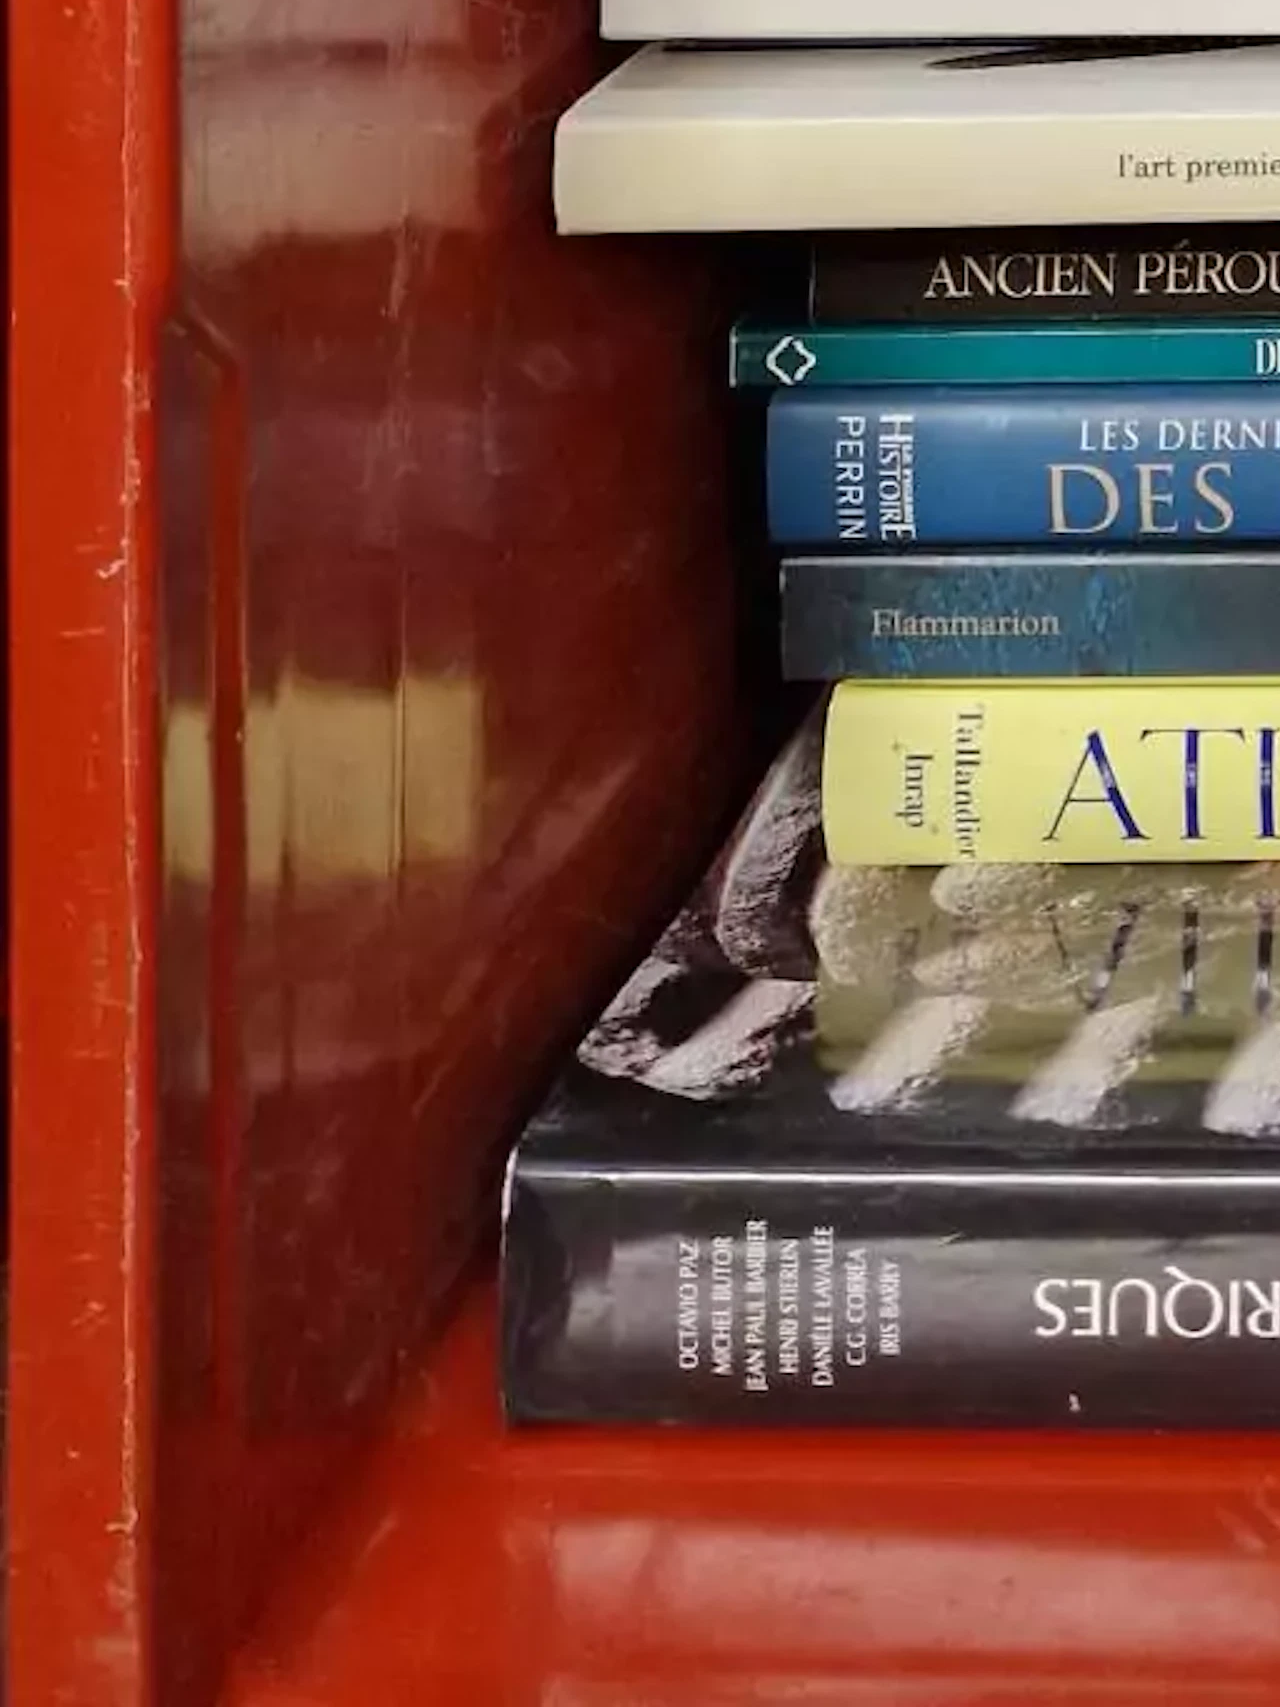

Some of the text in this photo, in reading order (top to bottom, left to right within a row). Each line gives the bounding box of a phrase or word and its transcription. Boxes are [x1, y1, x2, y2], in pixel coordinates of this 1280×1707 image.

[1118, 152, 1175, 178] l'art
[922, 250, 1119, 300] ANCIEN
[1078, 419, 1141, 453] LES
[834, 415, 868, 540] PERRIN
[1048, 460, 1238, 536] DES
[871, 607, 1062, 637] Flammarion
[893, 752, 935, 829] Inrap
[953, 703, 986, 861] Tallandier
[679, 1240, 699, 1369] OCTAVIO PAZ
[712, 1236, 734, 1376] MICHEL BUTOR
[778, 1318, 799, 1374] HENRI
[880, 1323, 901, 1356] IRIS
[745, 1347, 769, 1391] JEAN
